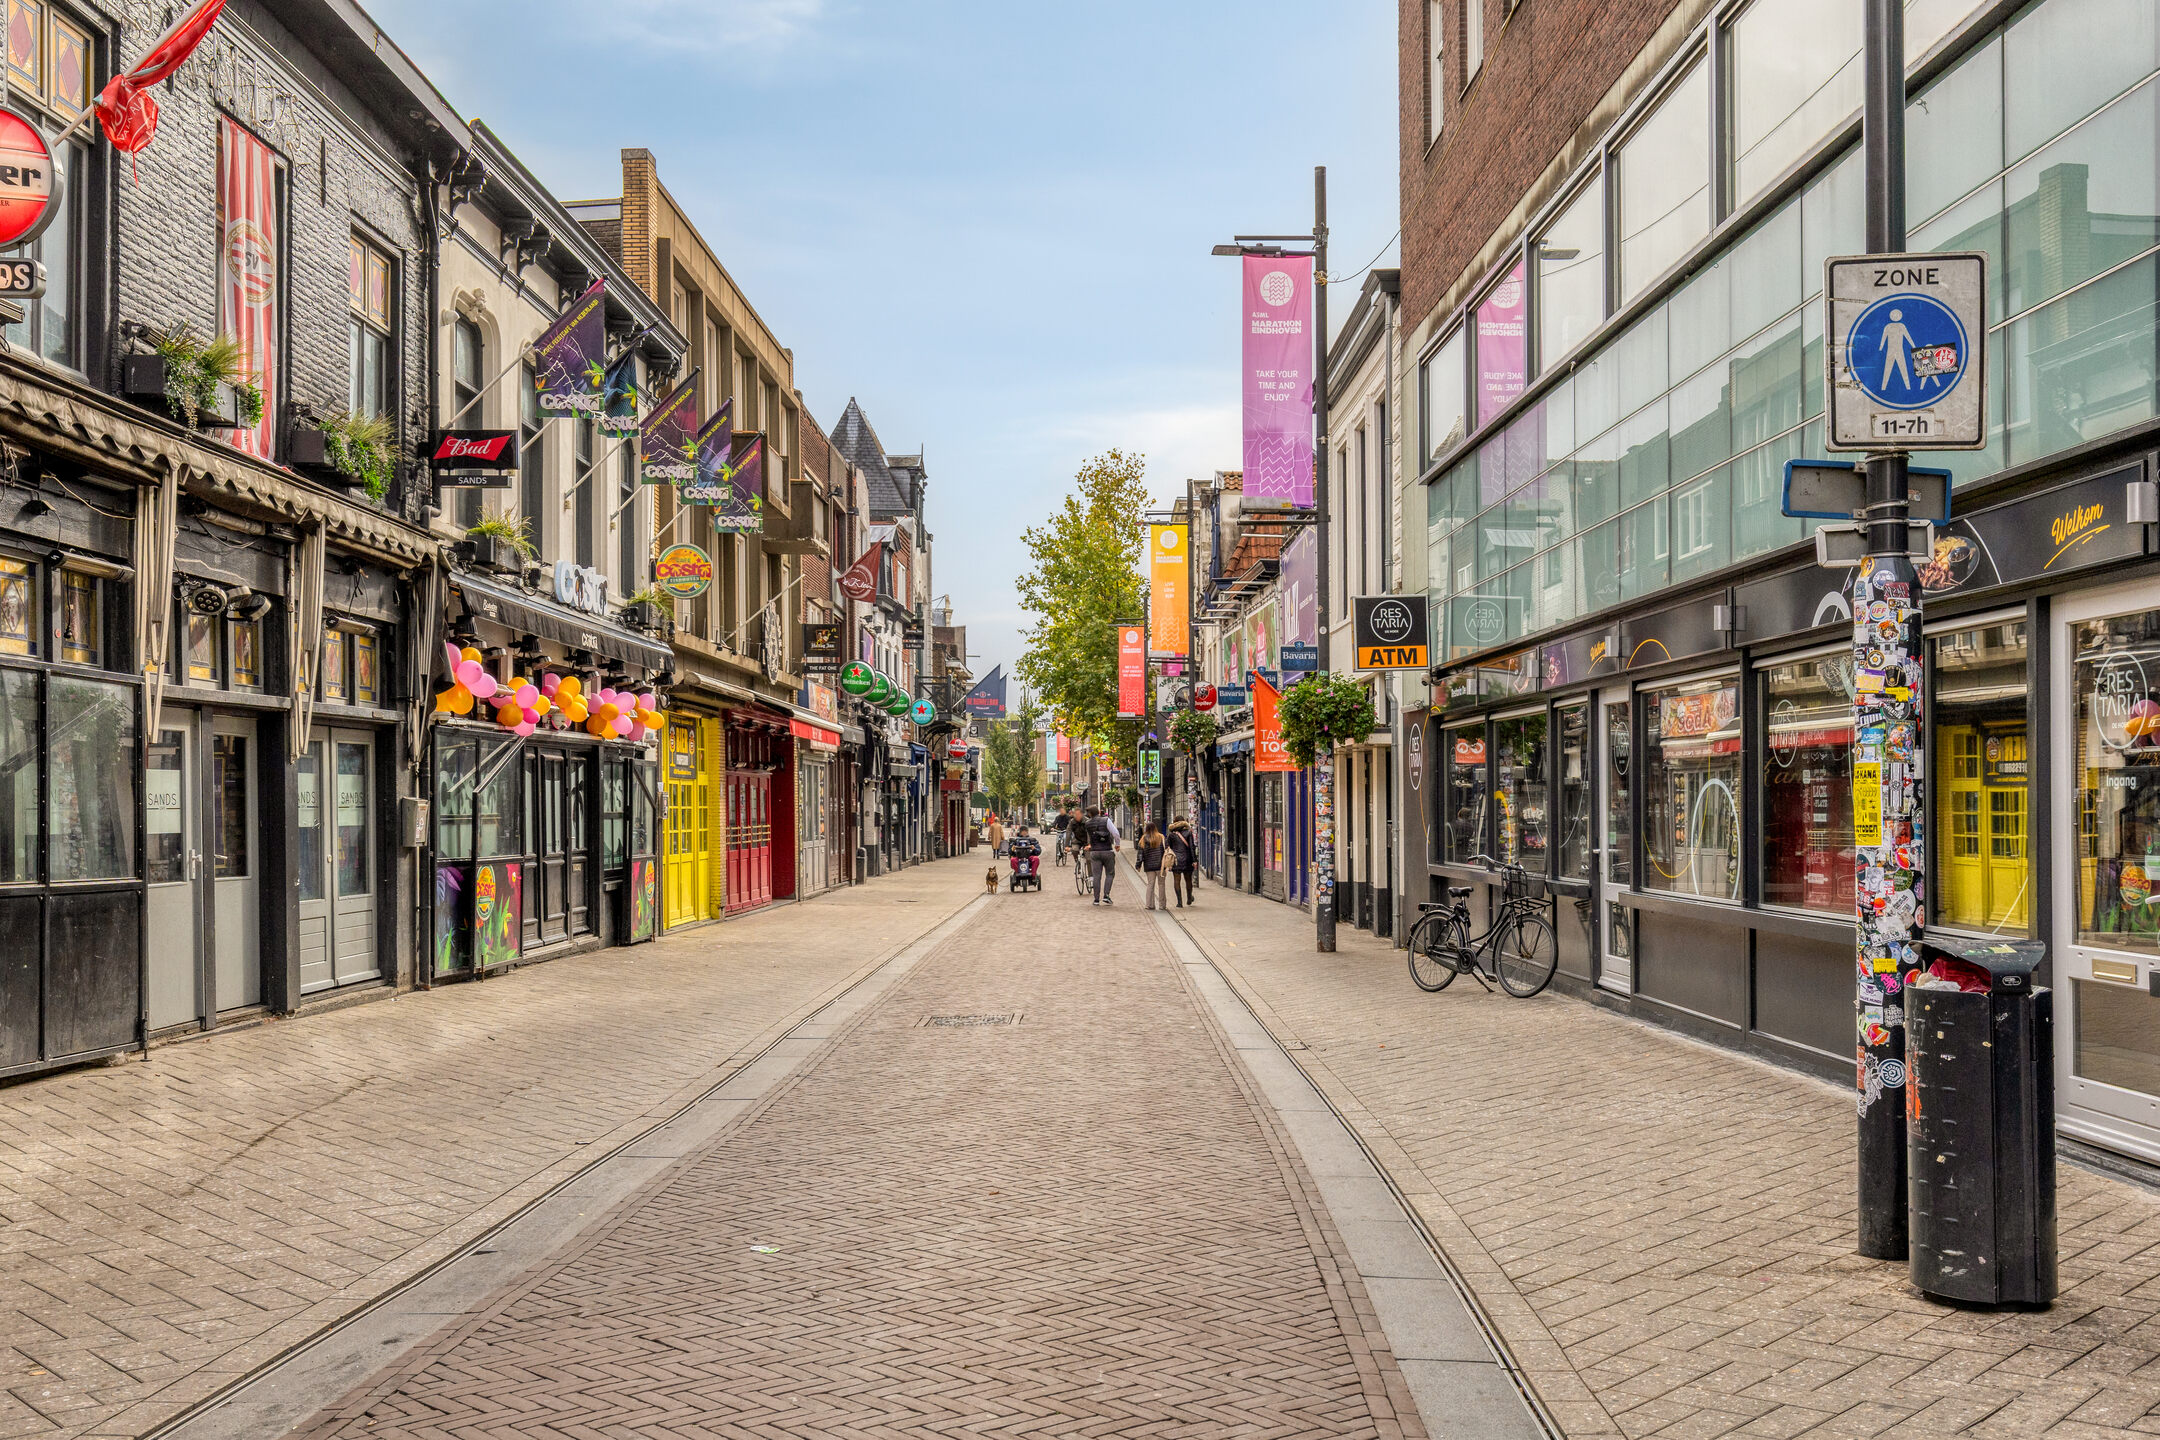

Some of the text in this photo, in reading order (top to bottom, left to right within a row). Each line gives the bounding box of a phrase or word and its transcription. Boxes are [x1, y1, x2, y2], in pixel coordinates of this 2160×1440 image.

[1874, 268, 1940, 287] ZONE
[1252, 320, 1302, 328] MARATHON
[1252, 327, 1302, 335] EINDHOVEN
[1256, 370, 1298, 378] TAKE YOUR
[1258, 382, 1296, 390] TIME AND
[1264, 394, 1290, 402] ENJOY
[1881, 416, 1929, 435] 11-7h
[446, 438, 490, 456] Bud
[458, 476, 487, 484] SANDS
[2052, 503, 2104, 546] Welkom
[1380, 608, 1402, 618] RES
[1374, 618, 1408, 628] TARIA
[1282, 651, 1316, 660] Bavaria
[1369, 648, 1418, 666] ATM
[2106, 670, 2134, 693] RES
[2099, 692, 2142, 717] TARIA
[2106, 775, 2136, 790] Ingang
[148, 793, 177, 806] SANDS
[341, 792, 363, 804] SANDS
